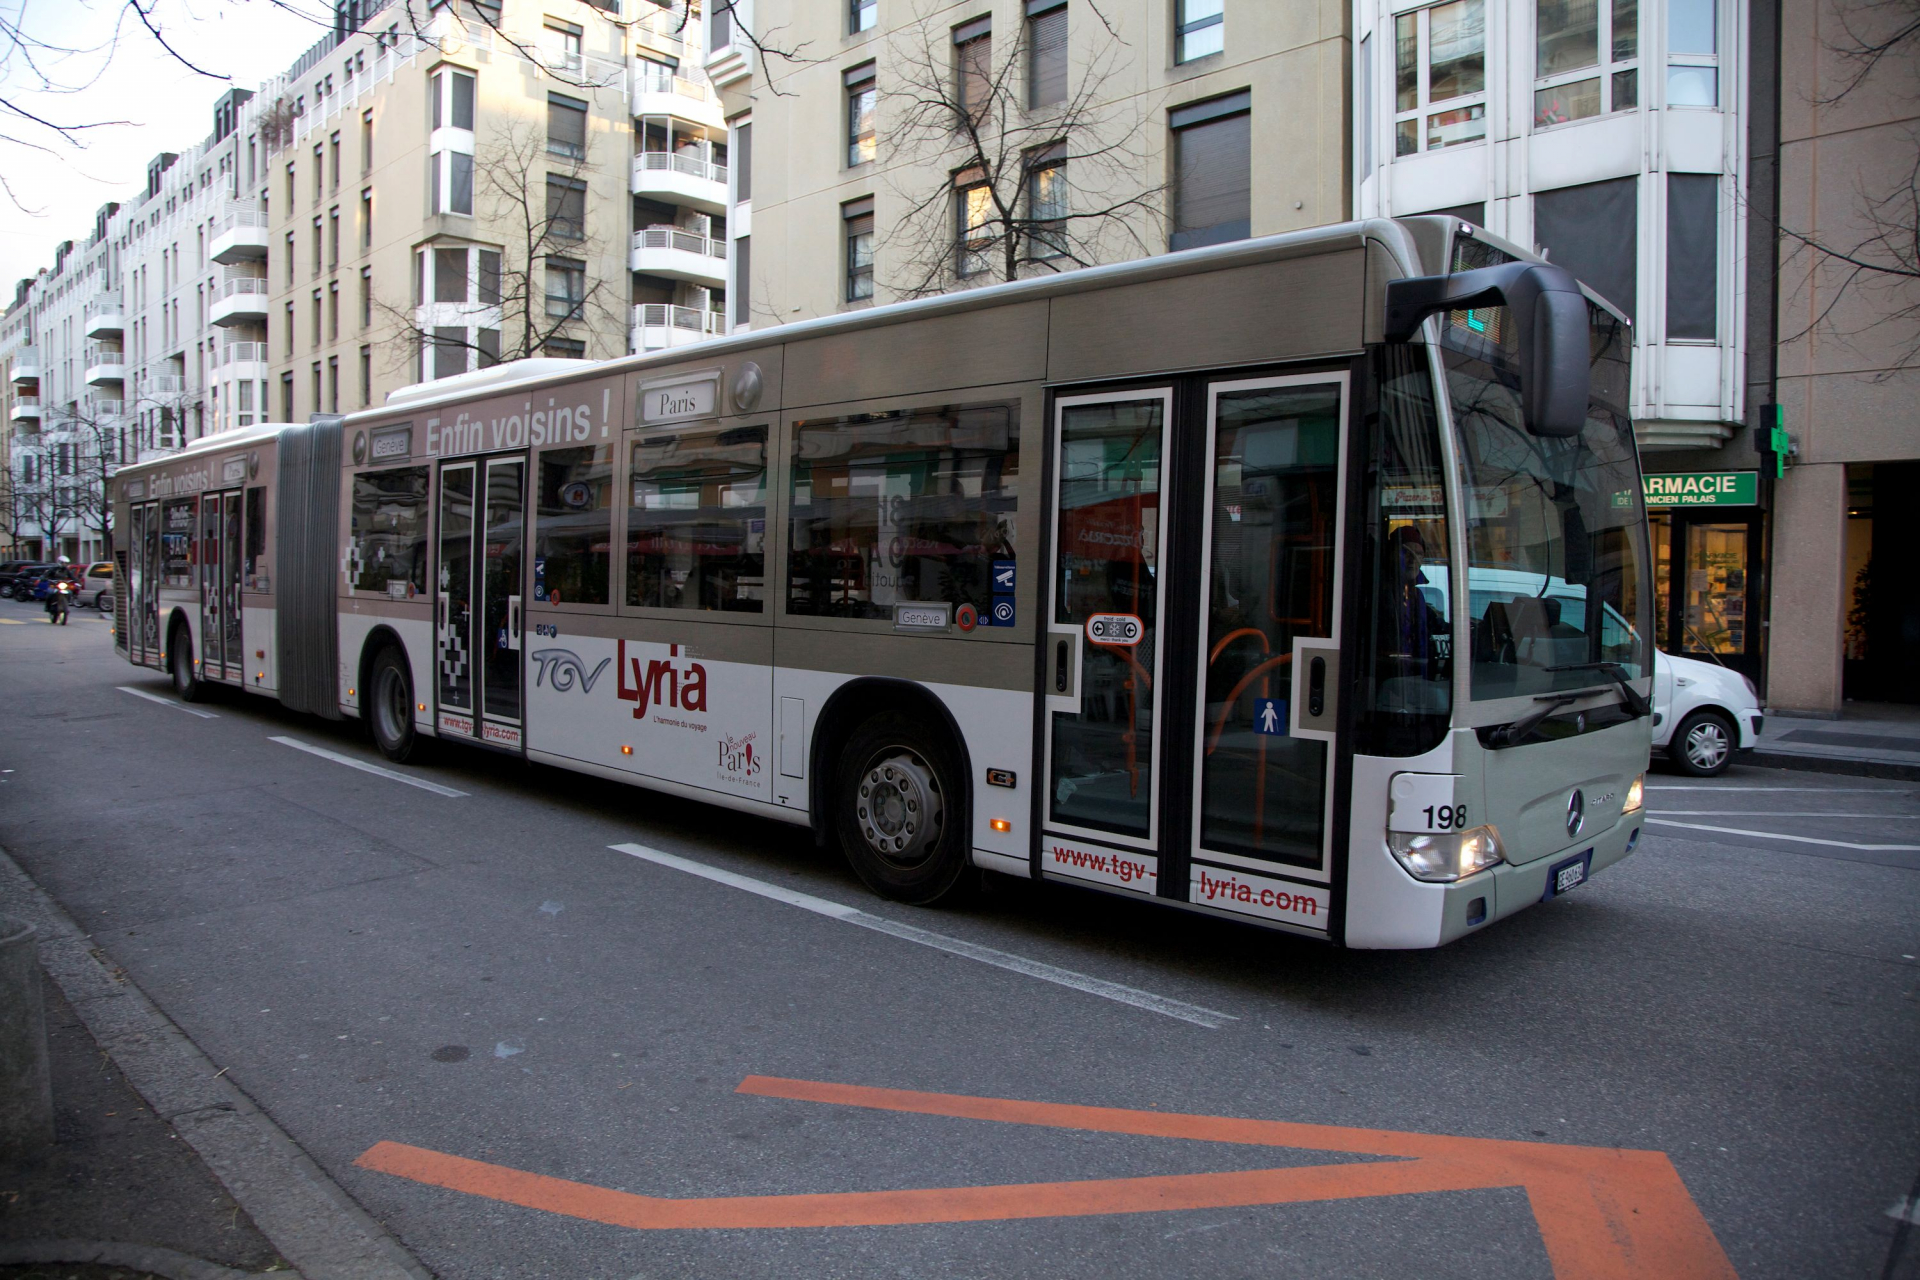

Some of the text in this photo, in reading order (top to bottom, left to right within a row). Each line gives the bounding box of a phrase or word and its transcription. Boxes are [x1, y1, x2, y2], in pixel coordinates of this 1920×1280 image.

[659, 390, 696, 416] Paris
[426, 413, 484, 459] Enfin
[491, 397, 591, 449] voisins
[376, 437, 404, 454] Genève
[150, 472, 172, 498] Enfin
[174, 465, 208, 495] voisins
[1681, 494, 1717, 504] PALAIS
[902, 610, 941, 625] Genève
[531, 638, 708, 720] TGV Lyria
[483, 722, 519, 742] lyria.com
[653, 715, 708, 733] L'harmonie du voyage
[729, 731, 757, 753] nouveau
[1422, 804, 1468, 830] 198
[1200, 870, 1317, 916] lyria.com
